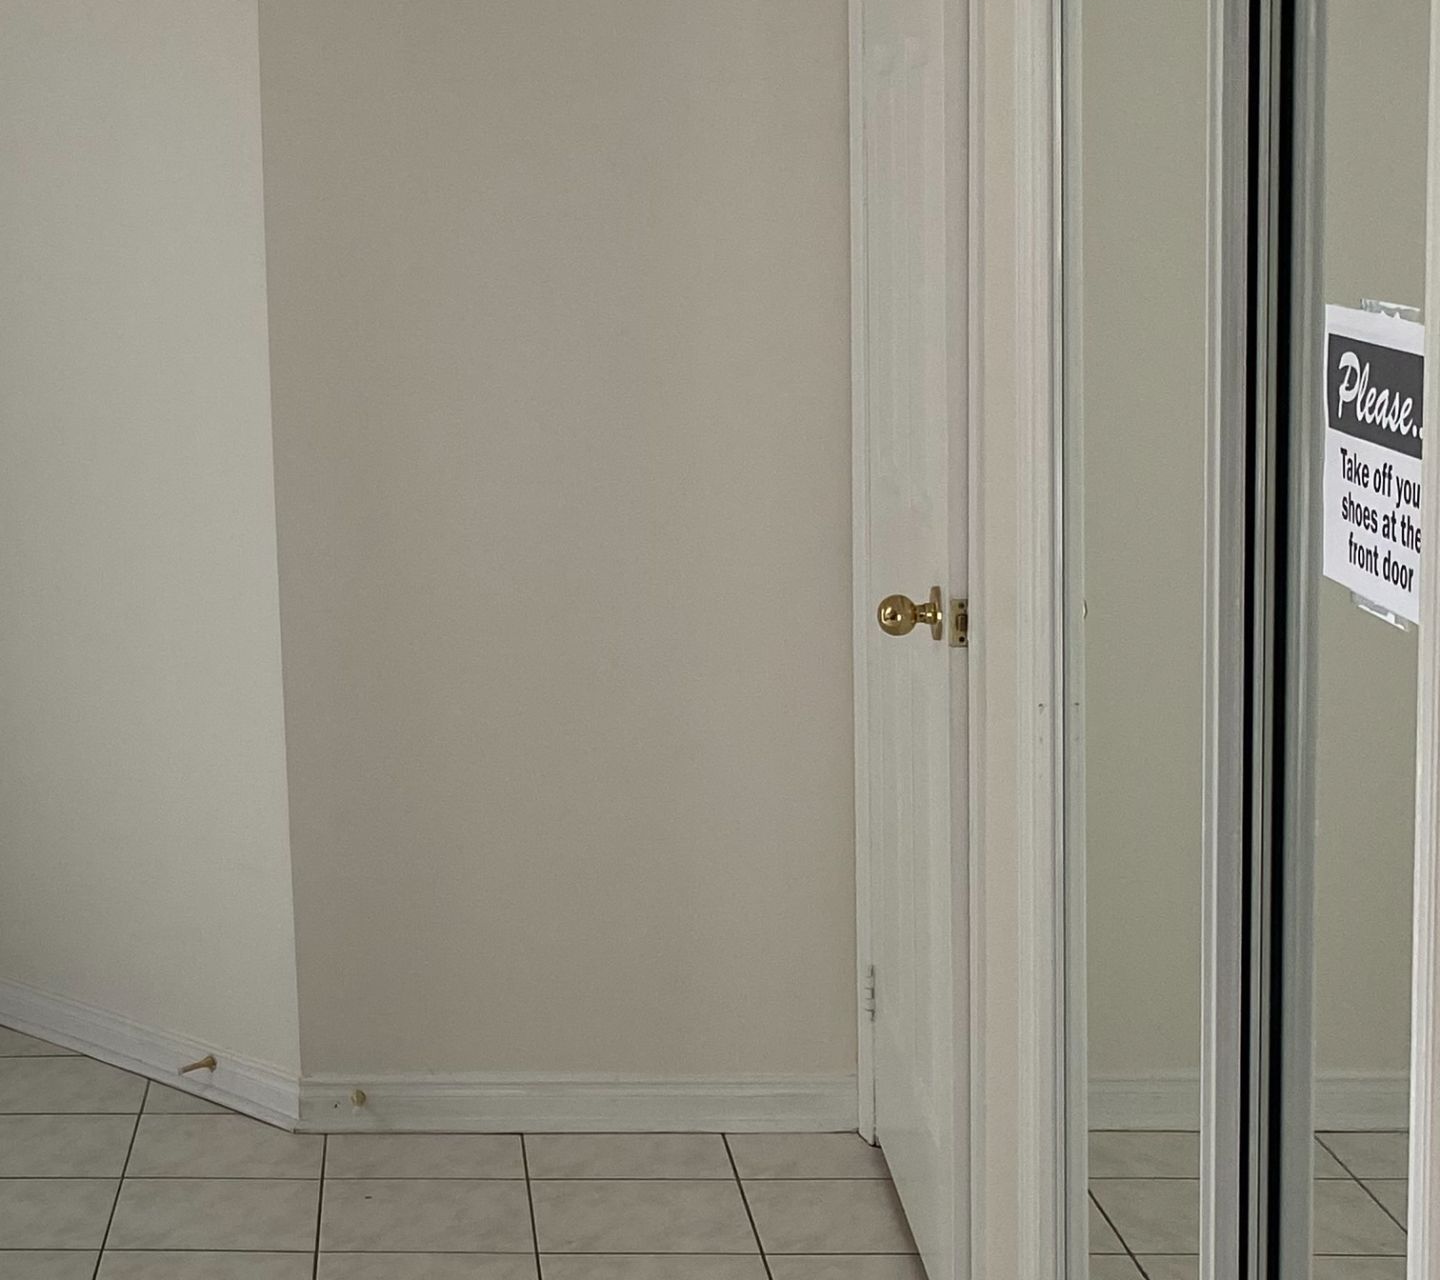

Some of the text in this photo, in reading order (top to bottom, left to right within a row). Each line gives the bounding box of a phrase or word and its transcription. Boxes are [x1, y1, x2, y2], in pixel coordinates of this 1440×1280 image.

[1340, 447, 1421, 510] Take off you
[1341, 491, 1421, 554] shoes at the
[1348, 531, 1414, 593] front door
